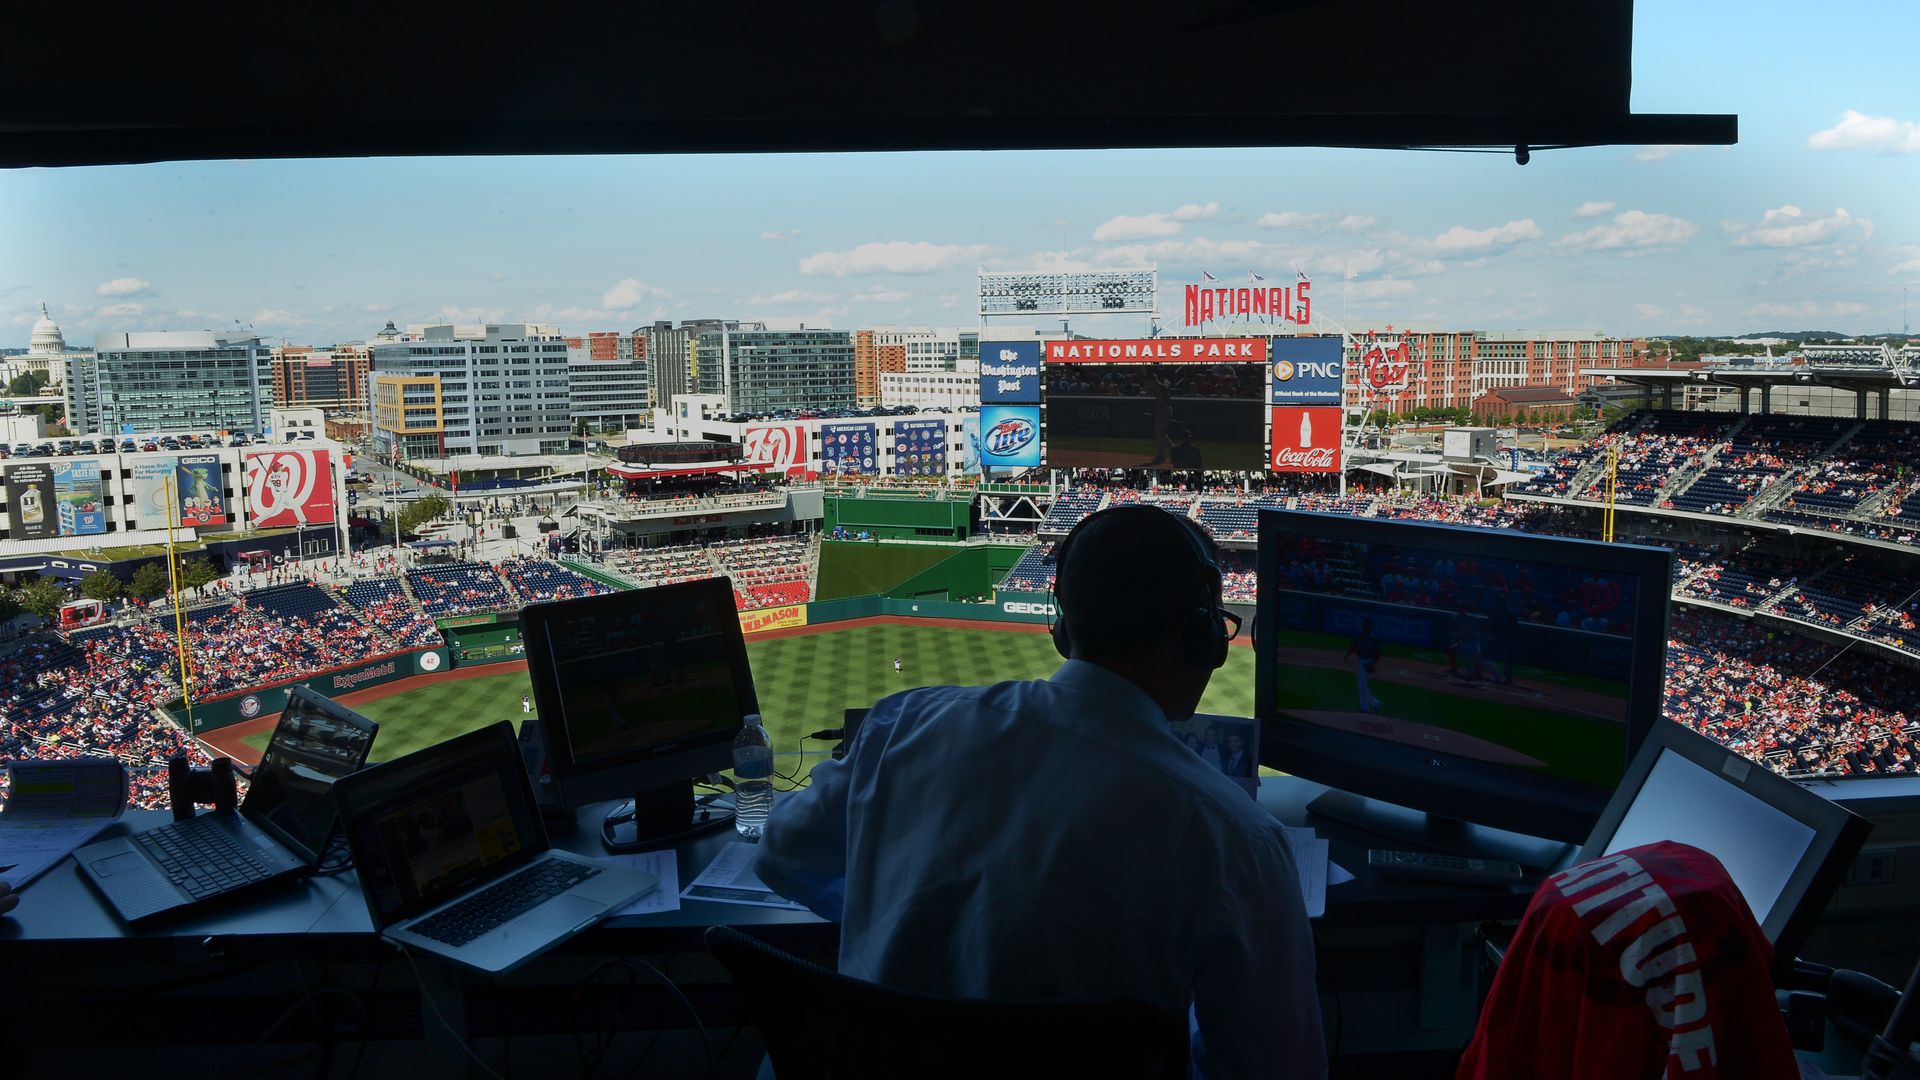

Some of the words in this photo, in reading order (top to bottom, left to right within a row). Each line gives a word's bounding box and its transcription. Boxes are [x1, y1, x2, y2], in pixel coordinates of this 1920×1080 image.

[1185, 282, 1311, 326] NATIONALS
[999, 349, 1018, 362] The
[1053, 344, 1182, 358] NATIONALS
[1194, 343, 1253, 357] PARK
[981, 363, 1038, 379] Washington
[1296, 362, 1340, 379] PNC
[997, 379, 1021, 395] Post
[992, 427, 1030, 452] Lite
[181, 456, 216, 465] GEICO
[1276, 447, 1336, 468] Coca-Cola
[1003, 601, 1057, 616] GEICO
[333, 661, 396, 689] ExxonMobil
